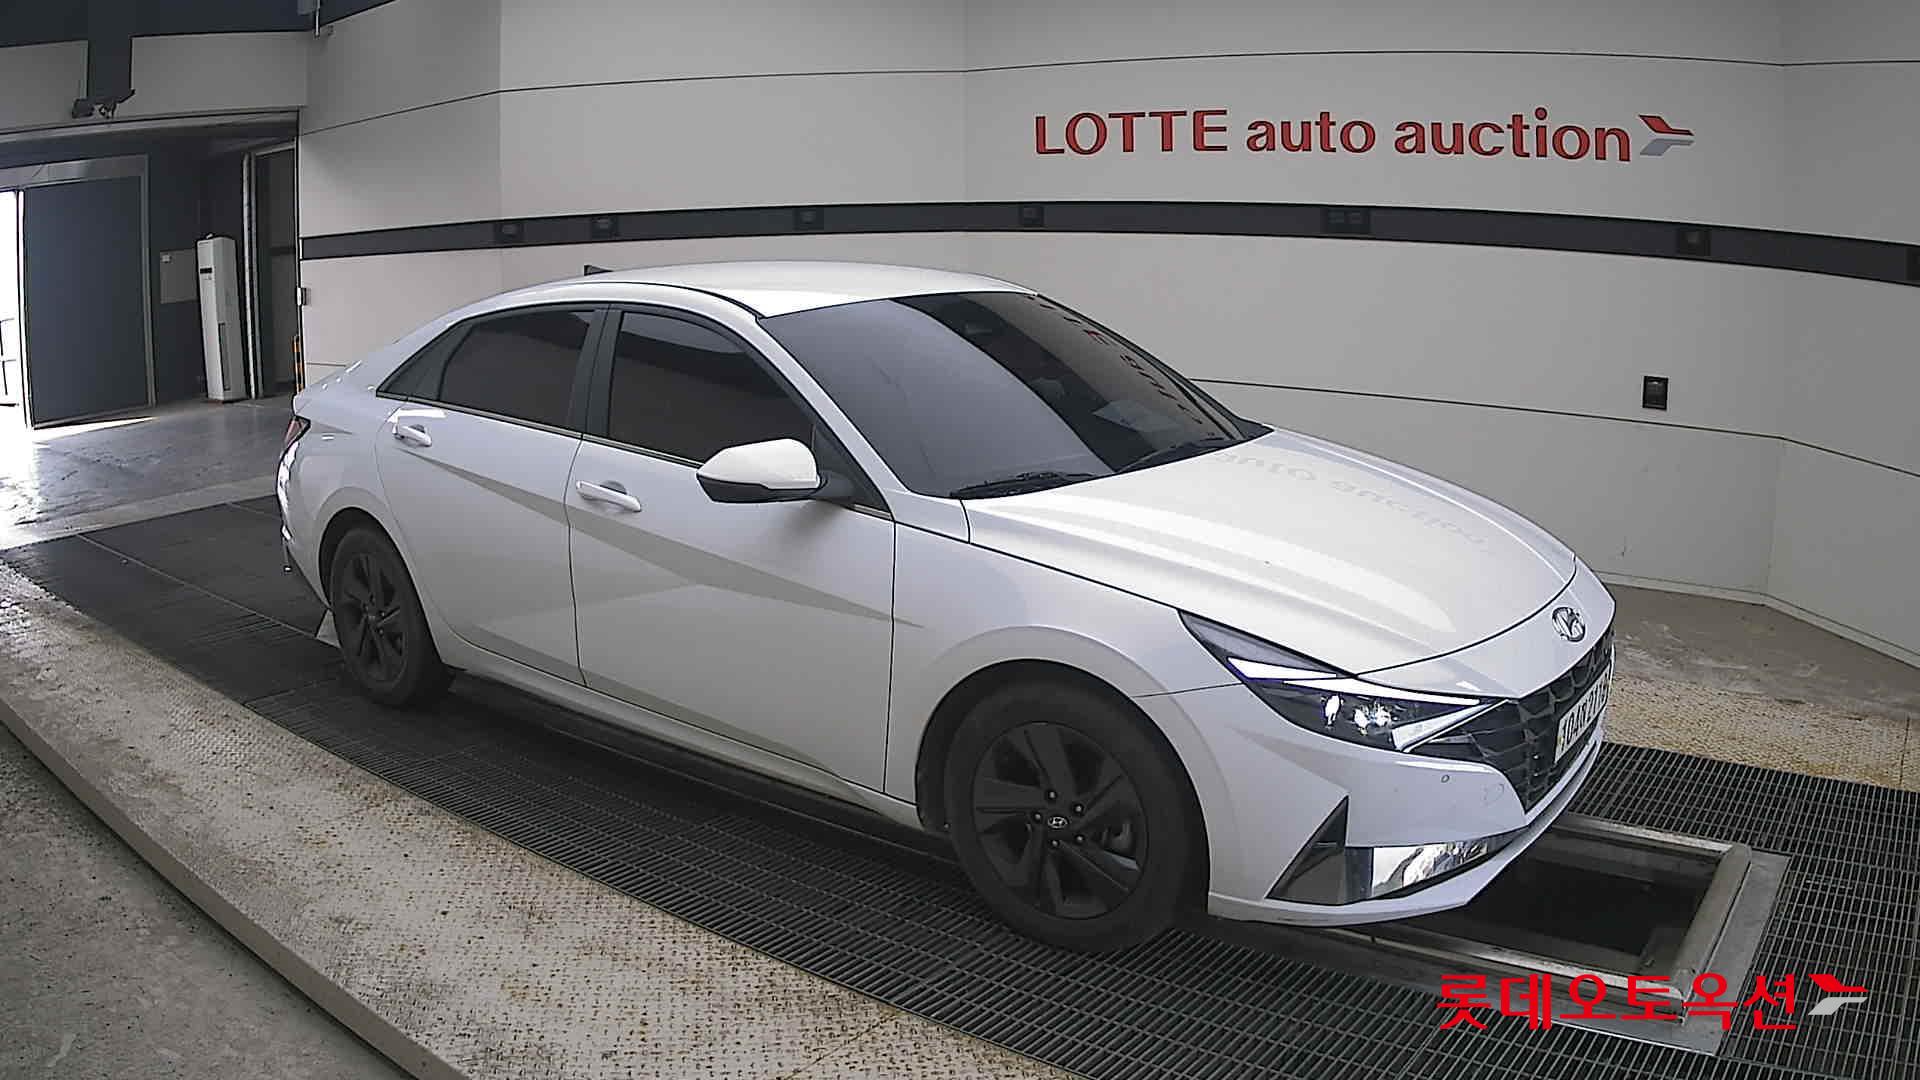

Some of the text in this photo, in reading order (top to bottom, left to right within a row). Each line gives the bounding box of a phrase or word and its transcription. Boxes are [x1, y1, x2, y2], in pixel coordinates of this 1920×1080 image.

[1034, 107, 1633, 162] LOTTE auto auction
